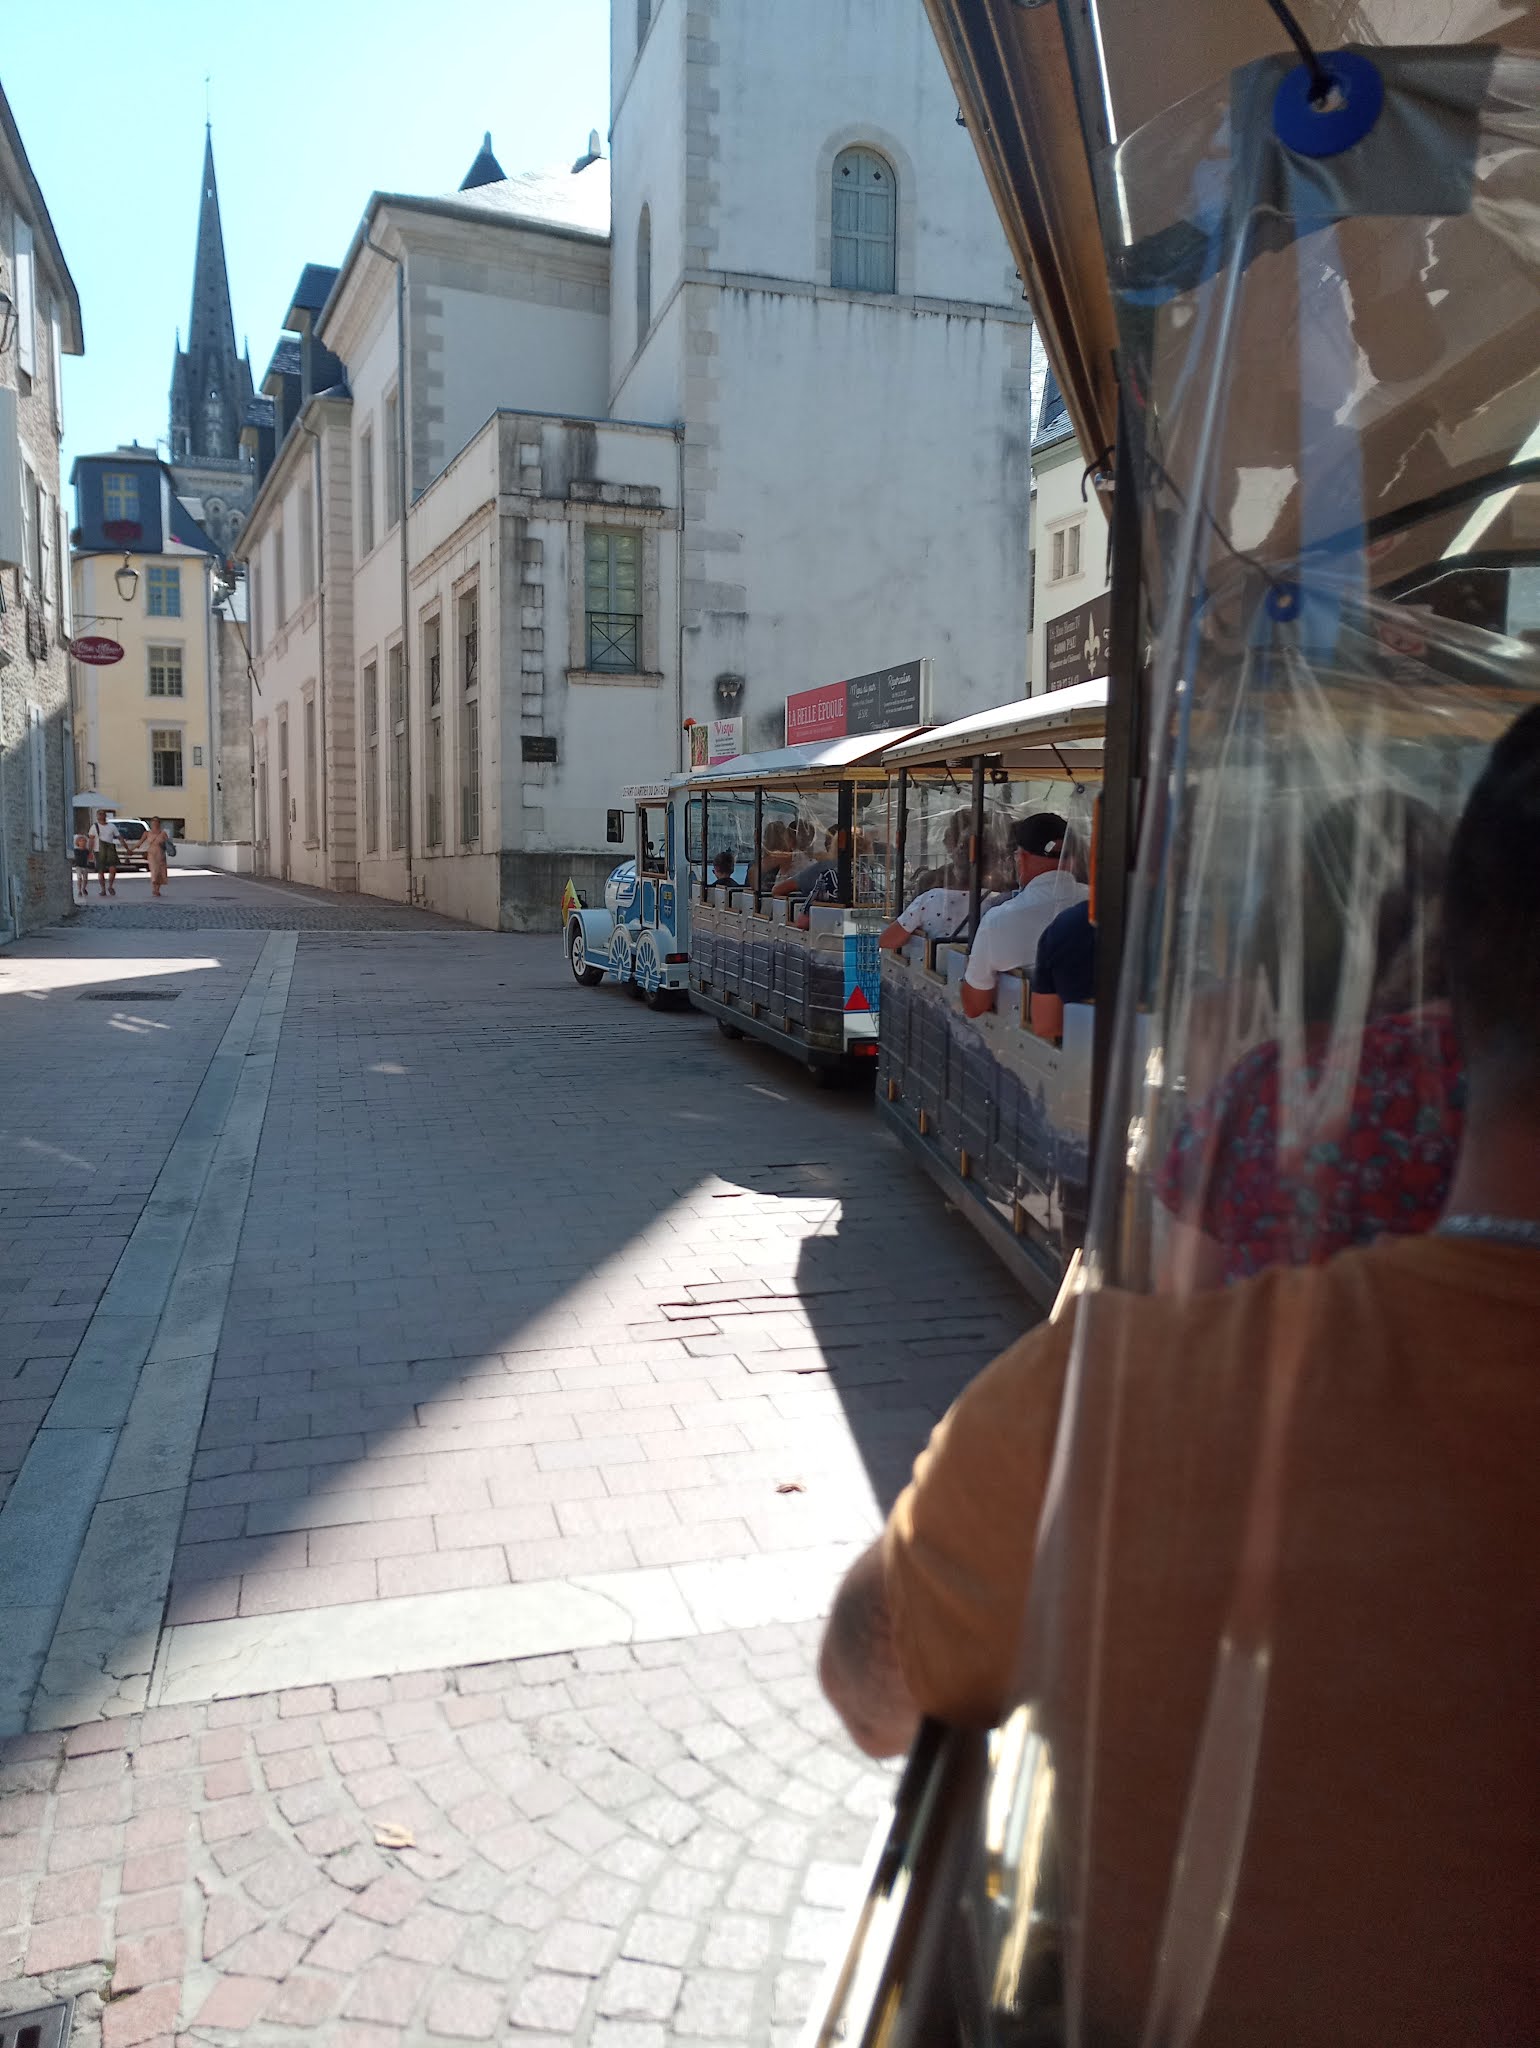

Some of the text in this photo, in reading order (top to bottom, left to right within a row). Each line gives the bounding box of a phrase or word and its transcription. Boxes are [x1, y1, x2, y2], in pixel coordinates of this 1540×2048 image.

[788, 710, 797, 727] LA
[797, 705, 817, 726] BELLE
[818, 698, 844, 721] ÉPOQUE
